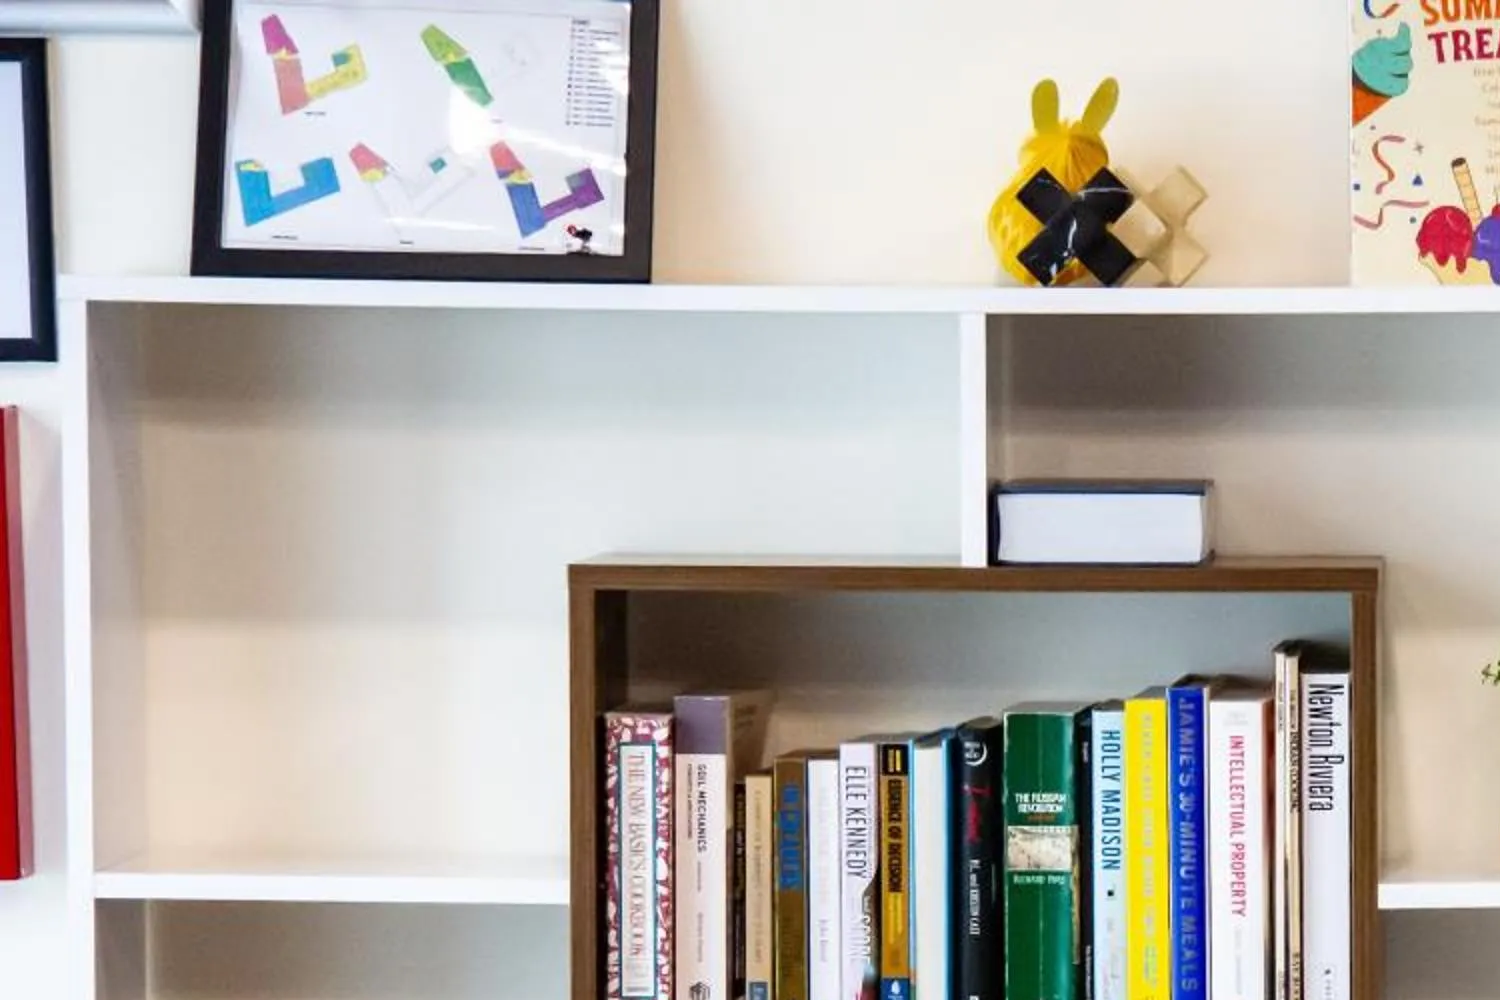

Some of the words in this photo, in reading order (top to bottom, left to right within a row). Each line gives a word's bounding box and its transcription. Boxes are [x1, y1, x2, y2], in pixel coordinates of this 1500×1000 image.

[1177, 697, 1197, 786] JAMIE'S
[1307, 683, 1344, 751] Newton,
[627, 753, 646, 783] THE
[697, 763, 707, 787] SOIL
[846, 766, 867, 801] ELLE
[1101, 730, 1121, 783] HOLLY
[1308, 755, 1344, 811] Riviera
[628, 785, 646, 819] NEW
[887, 779, 902, 823] ESSENCE
[1015, 793, 1030, 803] THE
[1031, 793, 1066, 803] RUSSIAN
[1229, 735, 1245, 838] INTELLECTUAL
[628, 822, 647, 872] BASICS
[697, 790, 707, 853] MECHANICS
[846, 807, 868, 879] KENNEDY
[887, 826, 901, 840] OF
[1101, 789, 1121, 871] MADISON
[887, 843, 901, 893] DECISION
[1179, 793, 1198, 909] 30-MINUTE
[1230, 842, 1245, 918] PROPERTY
[628, 875, 647, 957] COOKBOOK
[1180, 915, 1198, 991] MEALS
